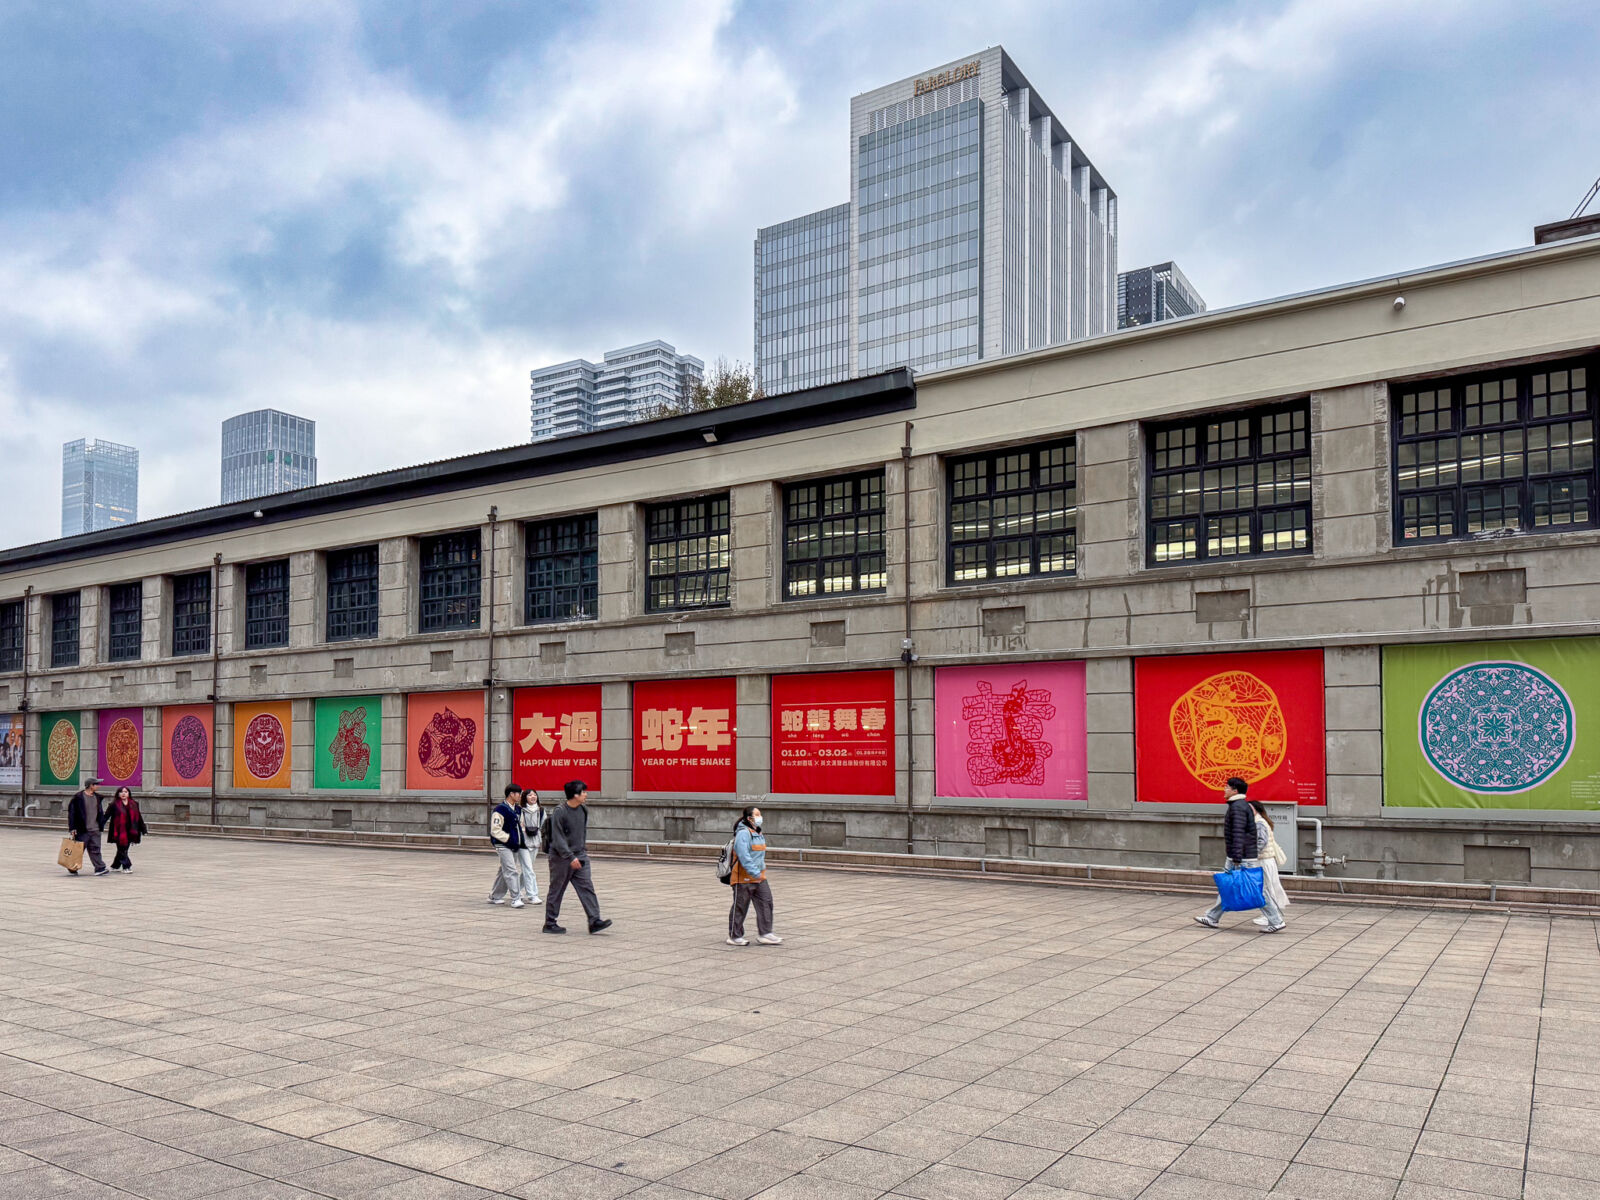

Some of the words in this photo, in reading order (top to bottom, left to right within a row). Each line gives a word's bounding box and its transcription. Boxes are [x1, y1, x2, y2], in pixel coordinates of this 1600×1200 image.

[914, 60, 980, 96] FARGLORY
[641, 707, 731, 751] 蛇年
[781, 708, 887, 732] 蛇龍舞春
[519, 712, 599, 753] 大過
[520, 759, 549, 767] HAPPY
[551, 759, 571, 767] NEW
[573, 759, 598, 767] YEAR
[642, 758, 664, 766] YEAR
[666, 758, 678, 766] OF
[680, 758, 698, 766] THE
[700, 758, 731, 766] SNAKE
[781, 749, 807, 757] 01.10
[818, 749, 848, 757] 03.02
